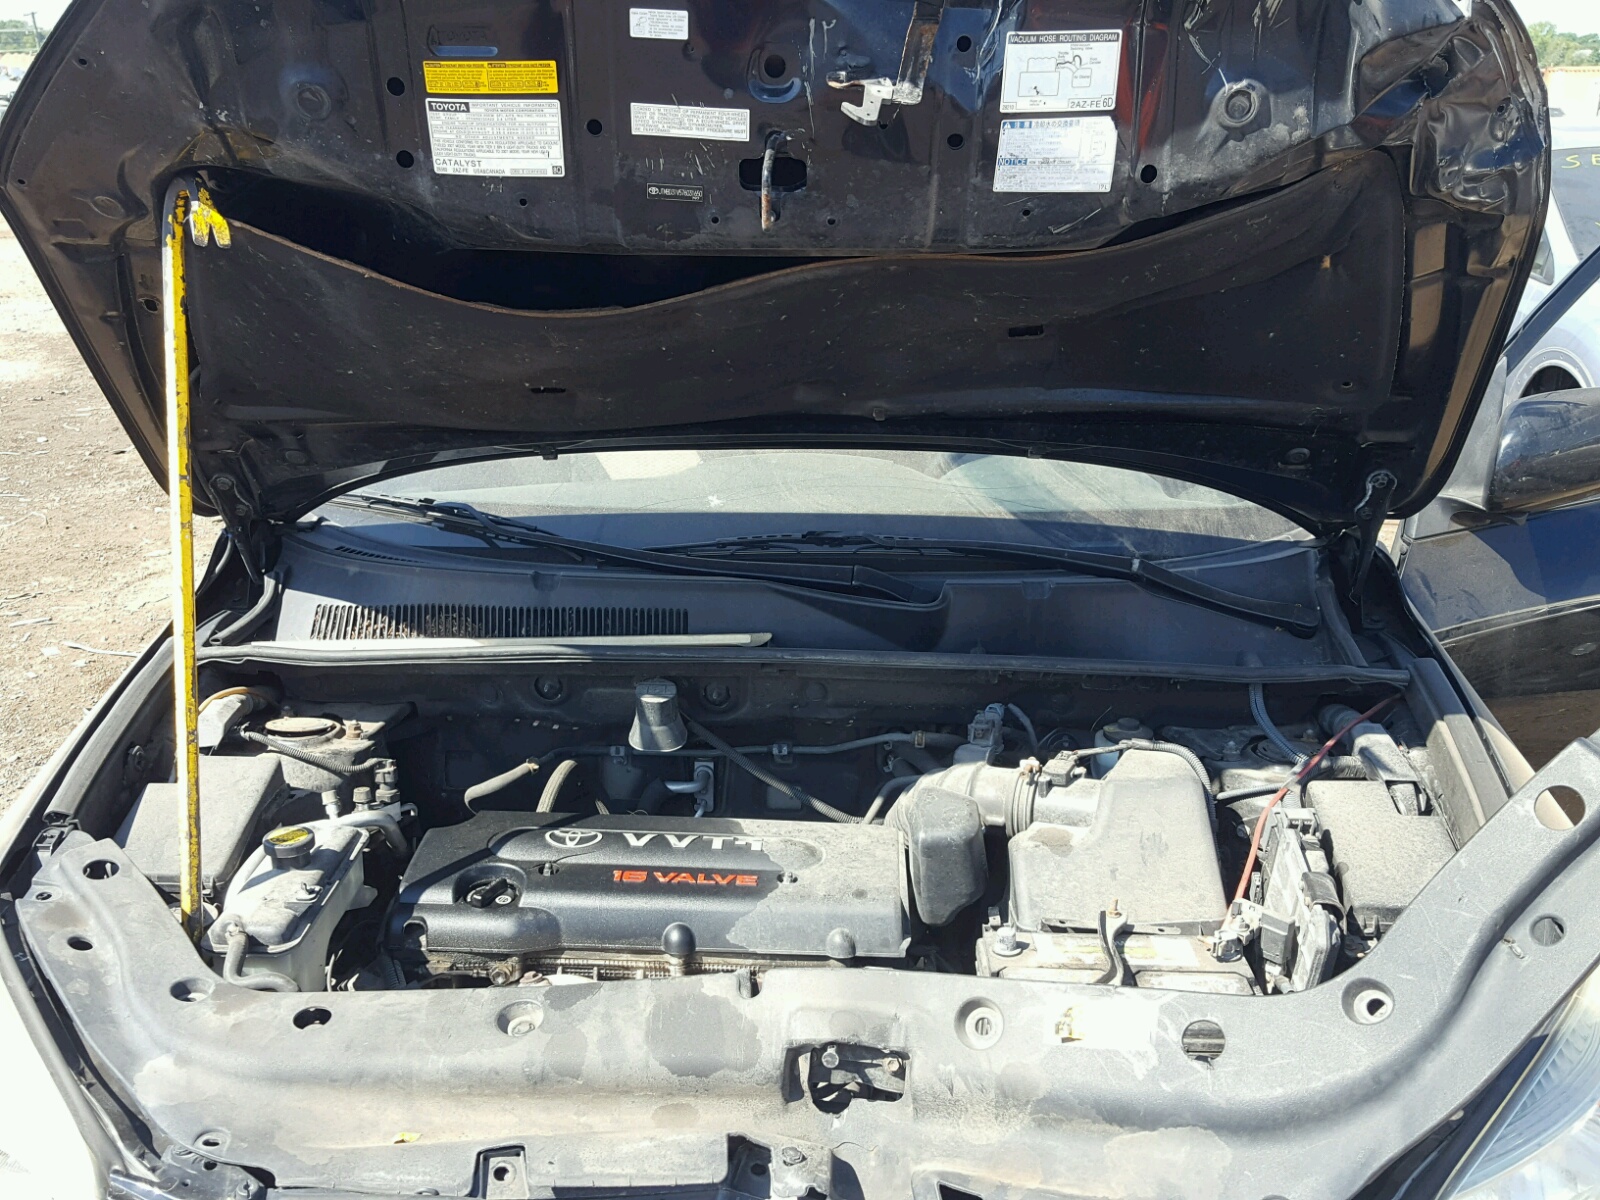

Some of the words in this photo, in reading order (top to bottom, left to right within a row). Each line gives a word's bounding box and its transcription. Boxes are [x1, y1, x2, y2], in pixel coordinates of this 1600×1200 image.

[430, 102, 467, 111] TOYOTA
[1102, 98, 1113, 107] 6D
[435, 159, 482, 167] CATALYST
[612, 869, 648, 883] 16
[652, 870, 759, 887] VALVE
